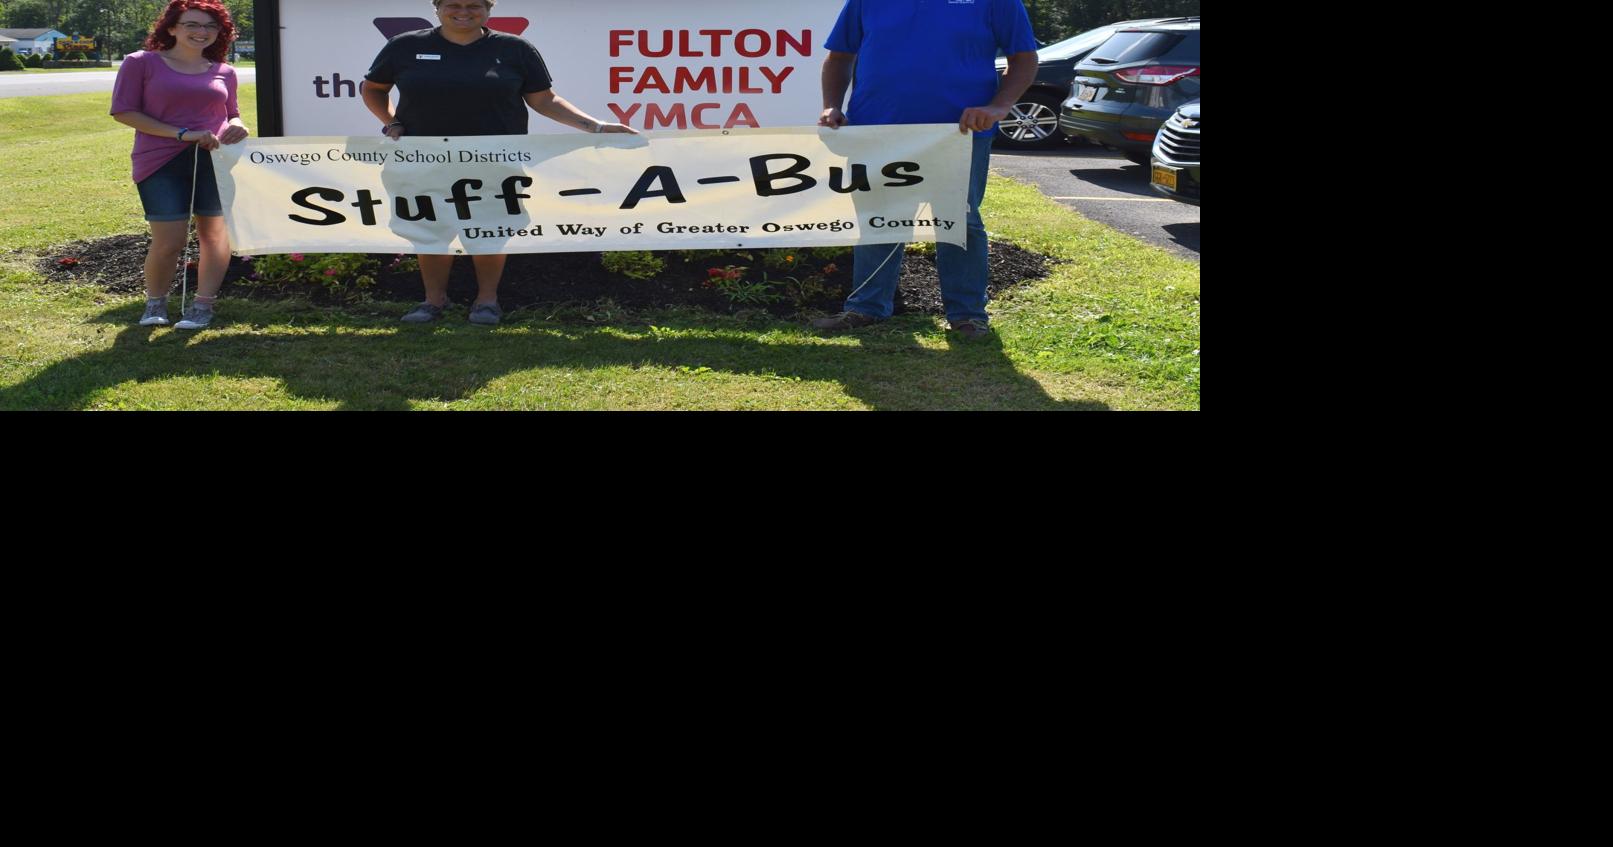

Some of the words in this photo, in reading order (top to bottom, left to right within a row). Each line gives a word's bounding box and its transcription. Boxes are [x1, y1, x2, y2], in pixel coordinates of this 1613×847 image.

[609, 29, 812, 58] FULTON
[313, 73, 366, 98] th
[609, 66, 794, 94] FAMILY
[607, 102, 760, 130] YMCA
[250, 150, 321, 166] Oswego
[327, 148, 388, 165] County
[393, 149, 452, 164] School
[458, 148, 532, 163] Districts
[463, 225, 542, 240] United
[555, 223, 607, 238] Way
[620, 223, 643, 236] of
[656, 221, 750, 235] Greater
[761, 219, 854, 233] Oswego
[868, 216, 956, 231] County
